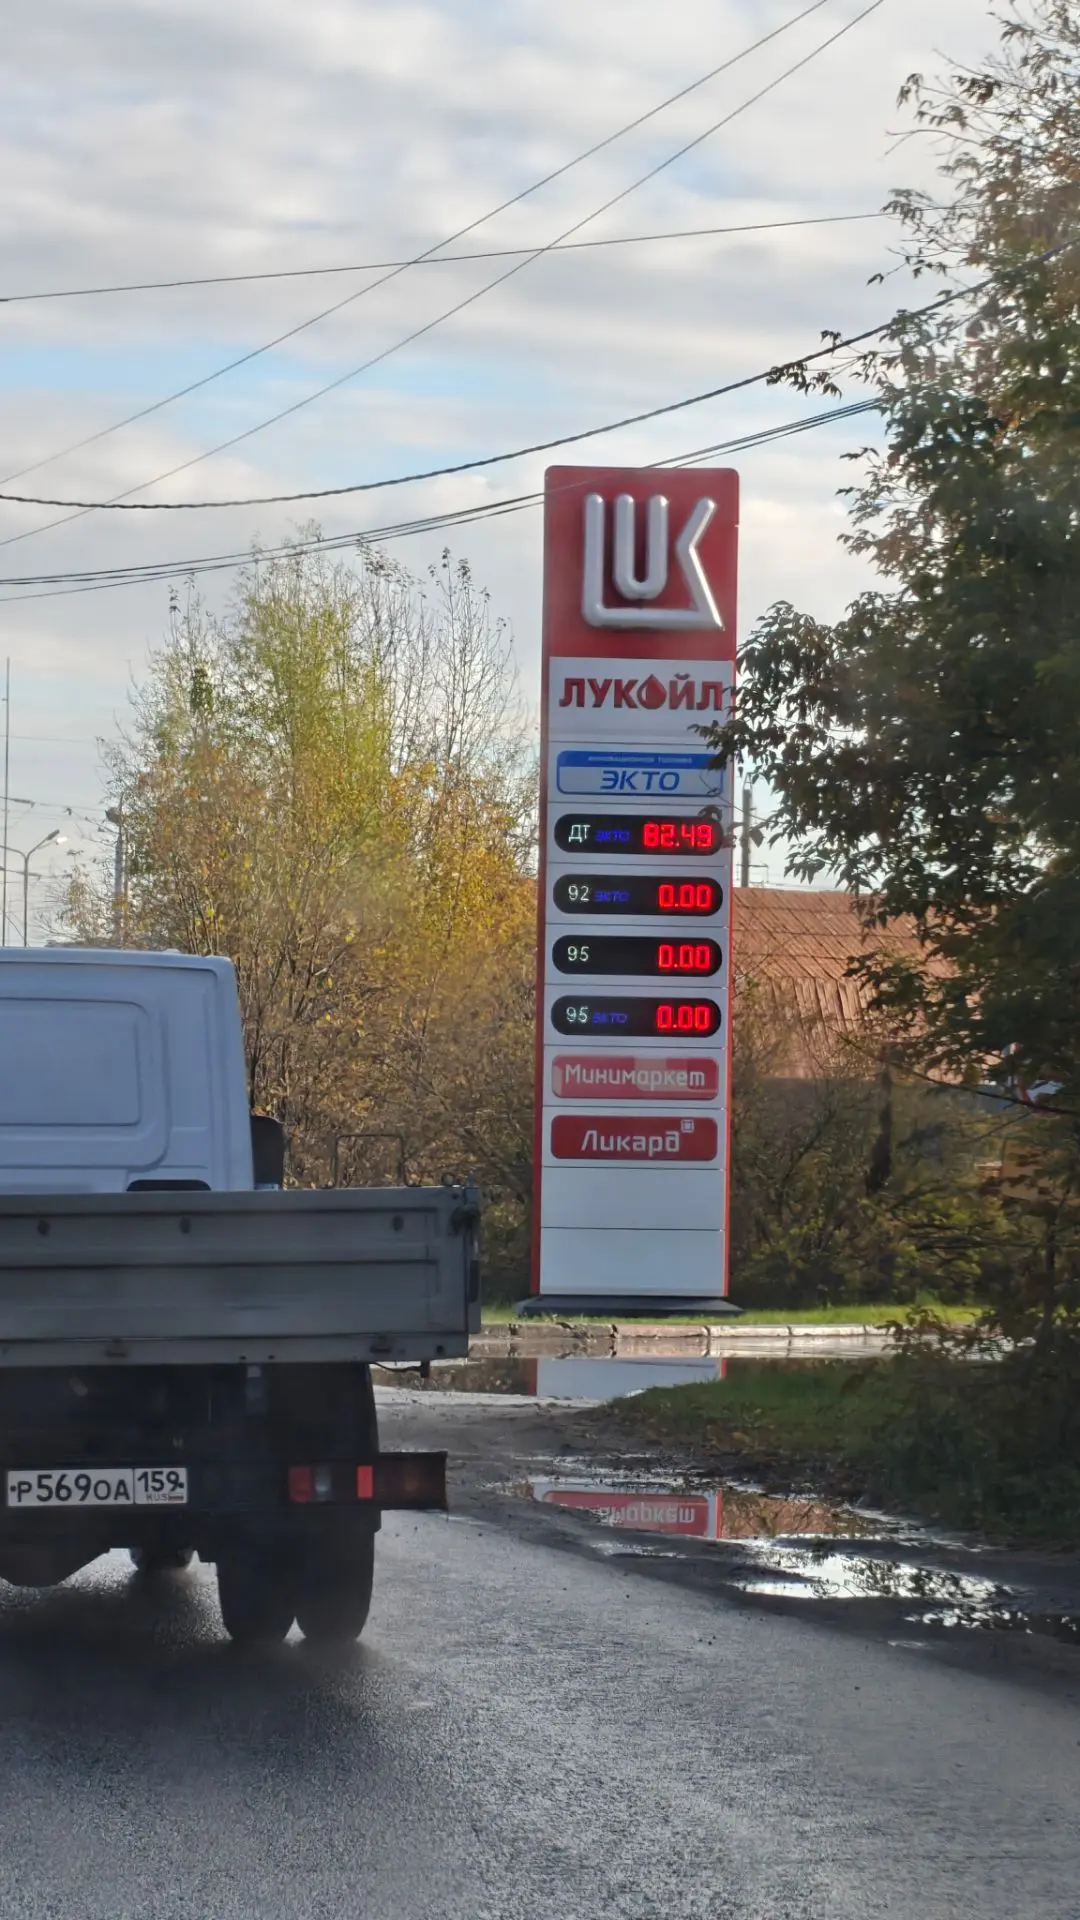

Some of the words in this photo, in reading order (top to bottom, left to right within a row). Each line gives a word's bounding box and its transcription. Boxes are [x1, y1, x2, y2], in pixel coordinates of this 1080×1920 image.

[558, 673, 723, 711] ЛУКОЙЛ
[601, 770, 680, 791] ЭКТО
[568, 824, 591, 843] ДТ
[643, 823, 712, 847] 82.49
[568, 884, 590, 902] 92
[659, 884, 712, 908] 0.00
[567, 946, 589, 962] 95
[658, 944, 711, 969] 0.00
[566, 1006, 588, 1023] 95
[657, 1005, 710, 1030] 0.00
[565, 1064, 705, 1091] Минимаркет
[581, 1130, 680, 1157] Ликард
